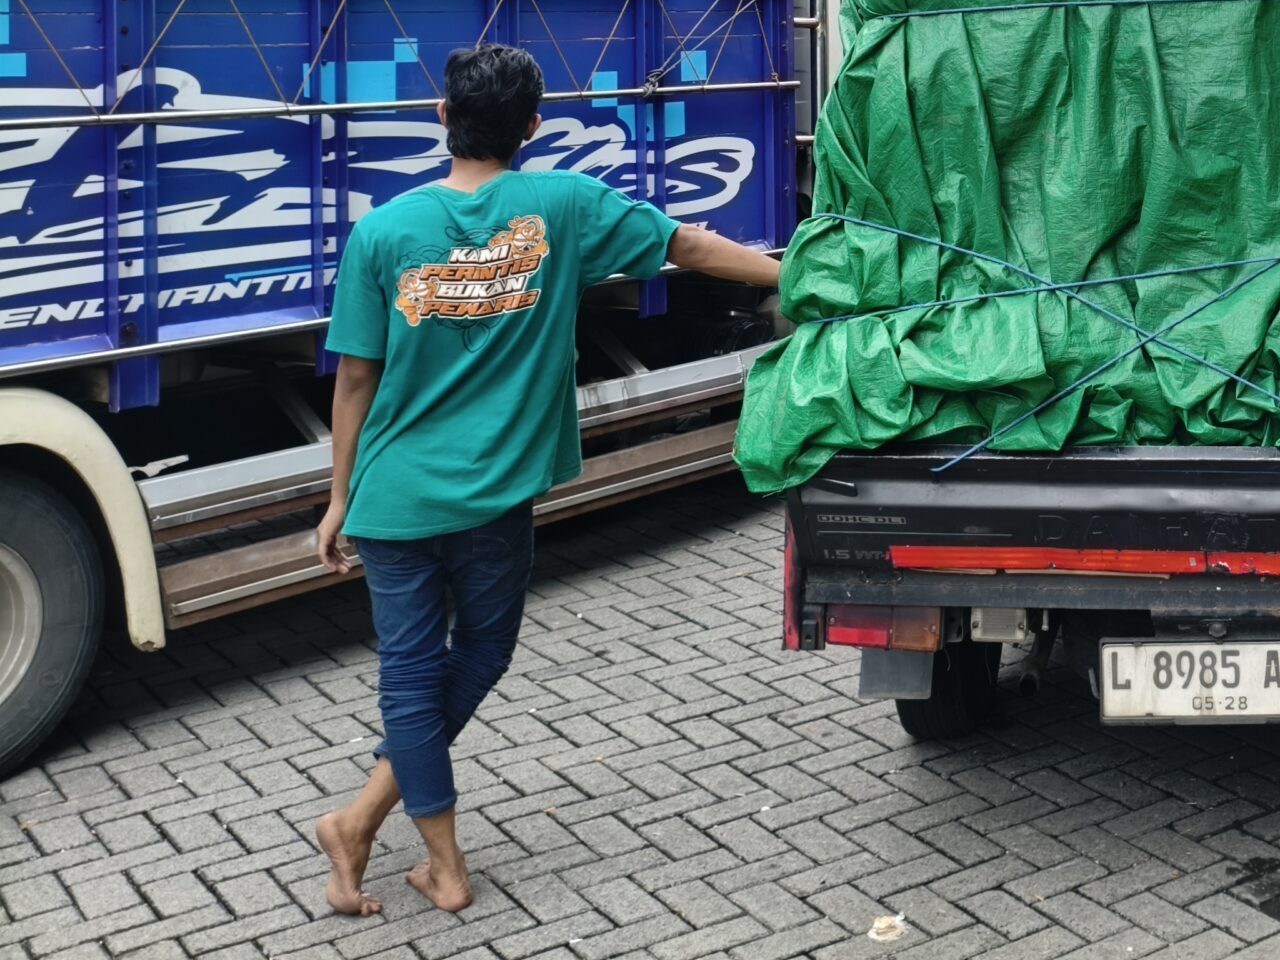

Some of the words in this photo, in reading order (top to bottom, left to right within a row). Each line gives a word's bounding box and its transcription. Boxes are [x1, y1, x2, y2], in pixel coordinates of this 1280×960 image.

[449, 243, 511, 264] KAMI
[419, 255, 541, 280] PERINTIS
[435, 276, 527, 299] BUKAN
[420, 291, 540, 317] PEWARIS
[817, 515, 869, 523] DOHC
[1110, 651, 1131, 690] L
[1153, 650, 1241, 690] 8985
